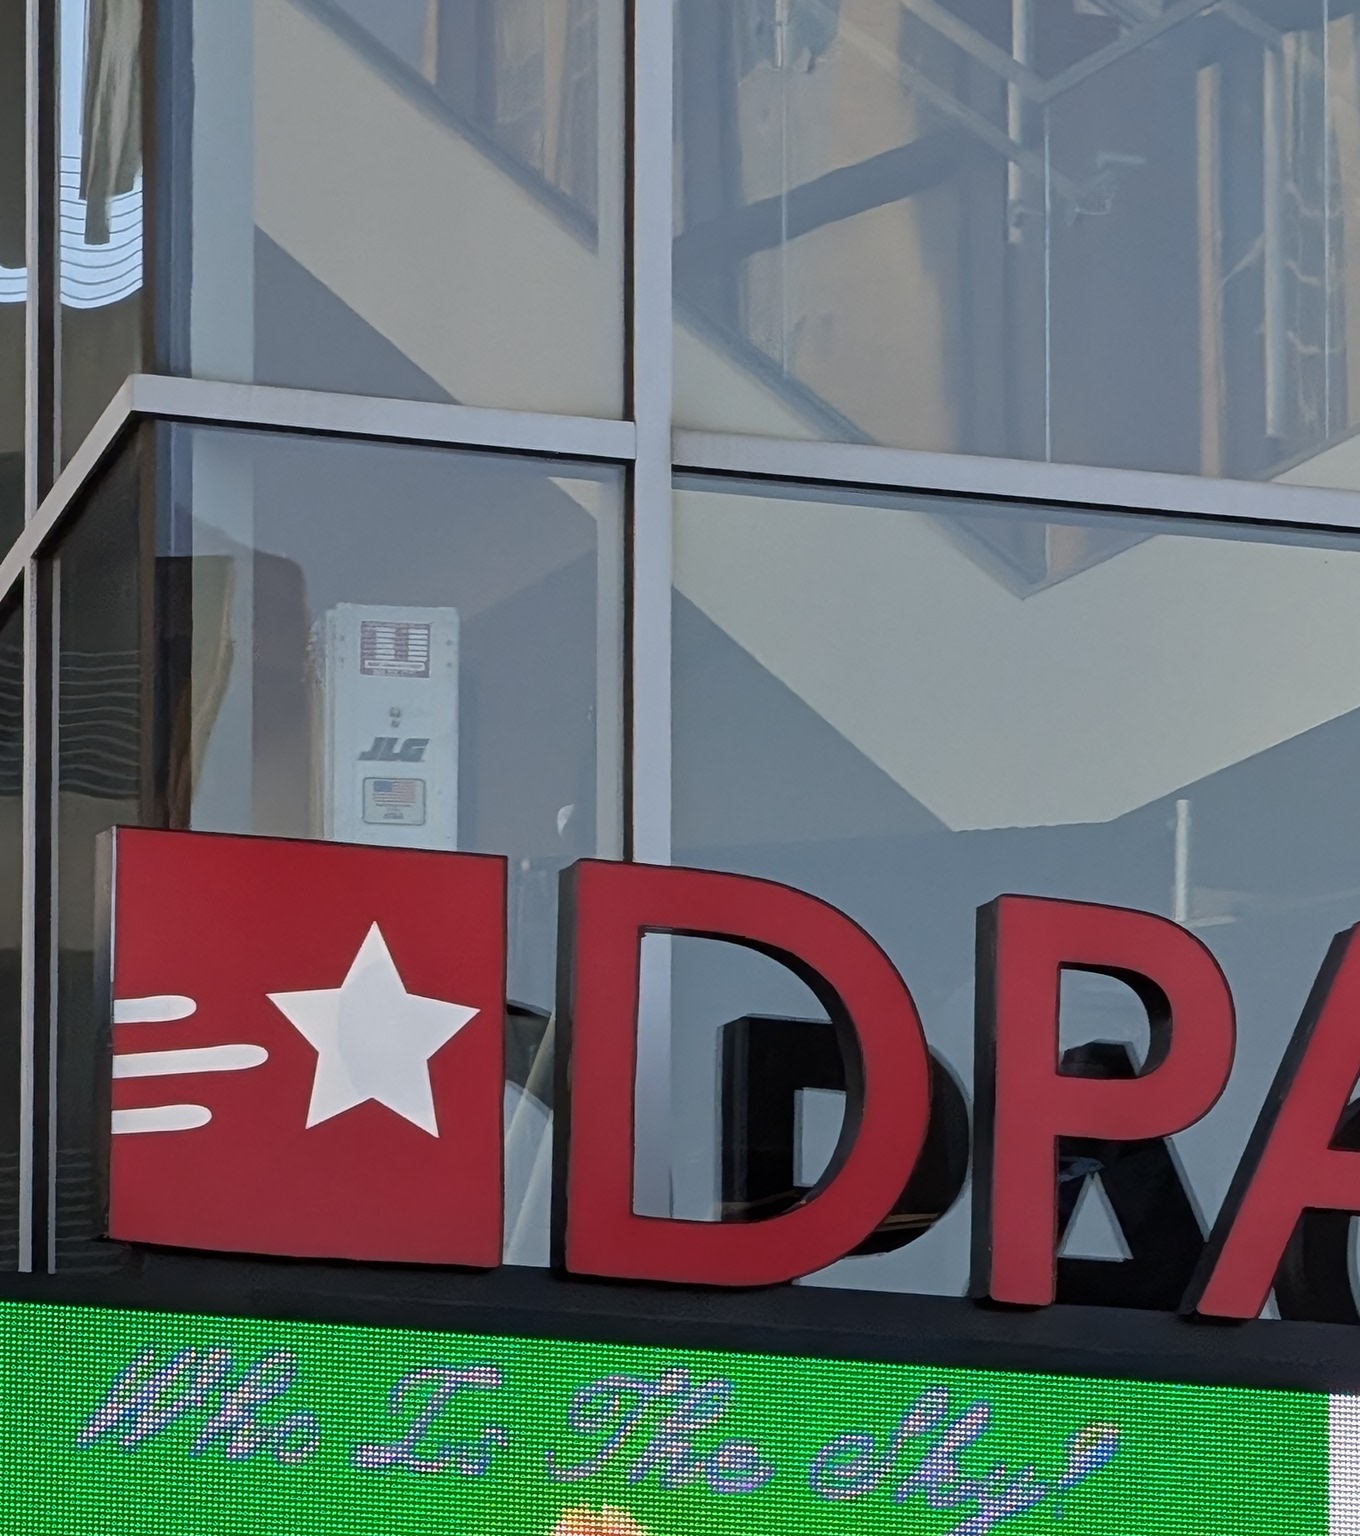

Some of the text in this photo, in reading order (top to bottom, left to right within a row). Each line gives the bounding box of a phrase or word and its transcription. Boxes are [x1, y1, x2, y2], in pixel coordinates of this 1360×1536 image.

[358, 737, 430, 762] JLG
[77, 1345, 322, 1467] Who
[351, 1362, 509, 1480] Is
[546, 1364, 776, 1494] The
